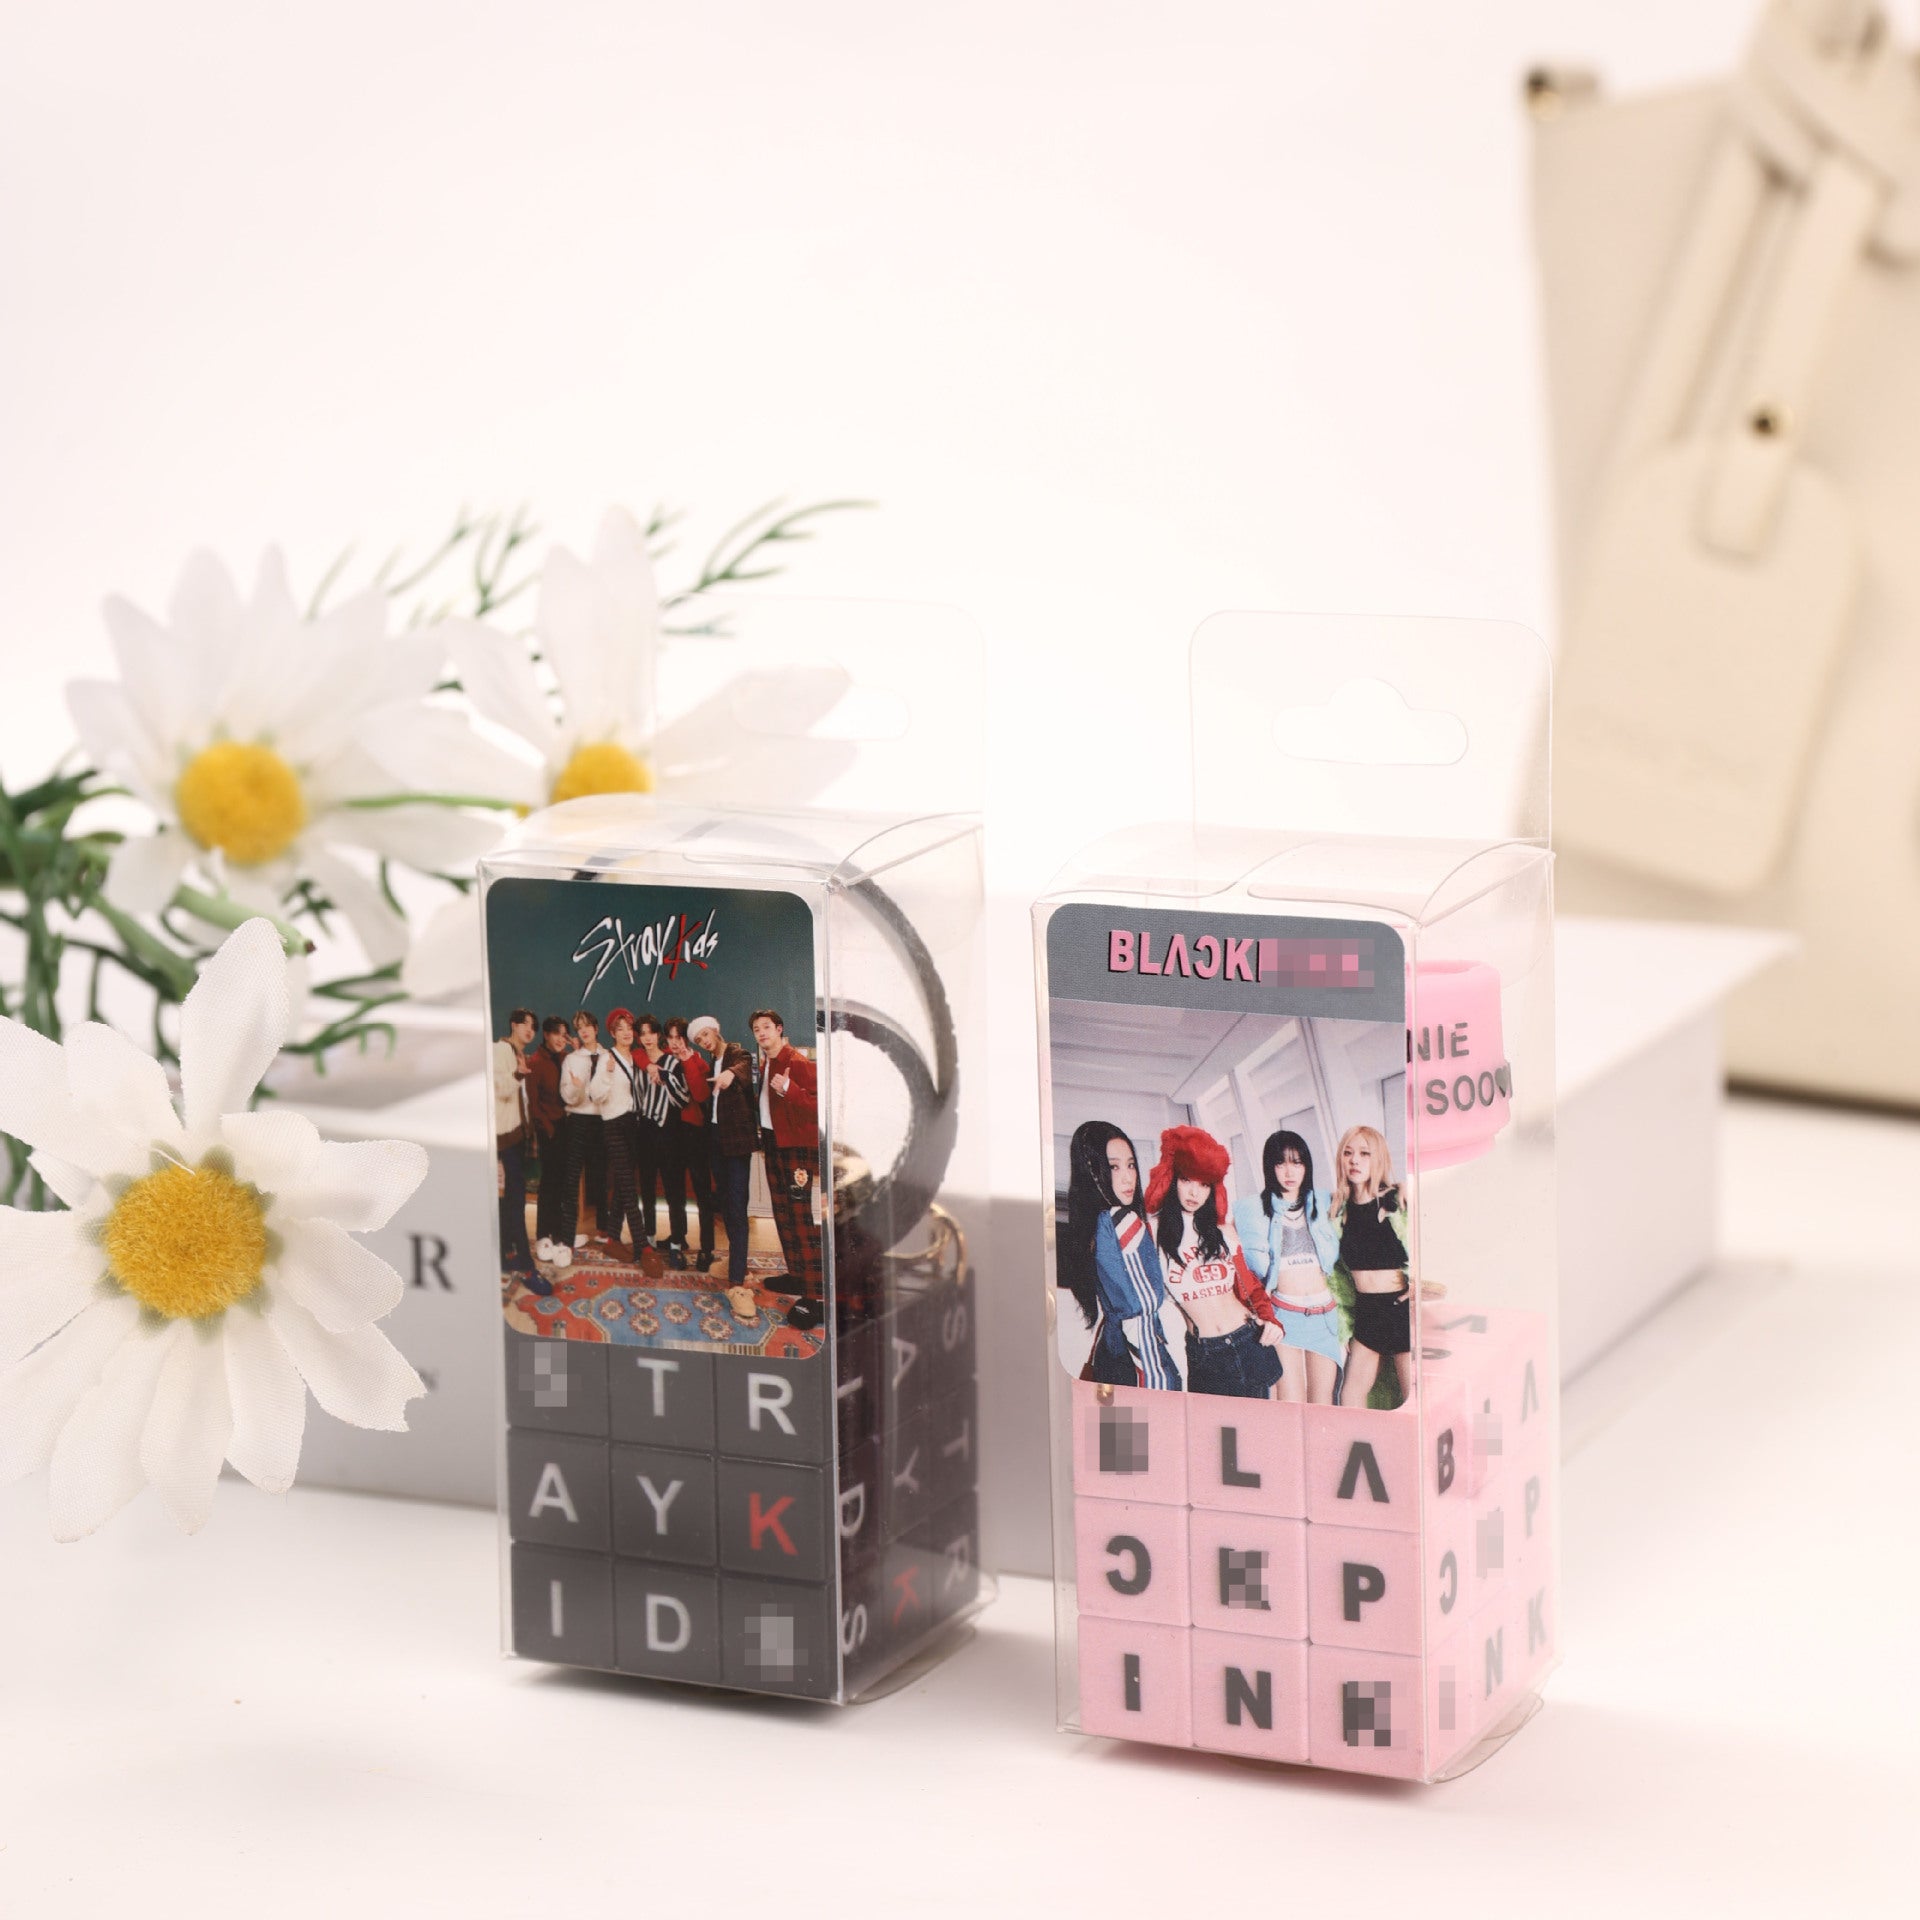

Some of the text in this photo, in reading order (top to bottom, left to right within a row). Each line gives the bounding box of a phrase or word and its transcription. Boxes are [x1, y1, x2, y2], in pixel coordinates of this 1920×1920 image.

[637, 1357, 680, 1417] T
[747, 1372, 797, 1436] R
[1220, 1426, 1261, 1489] L
[528, 1462, 799, 1556] A Y K
[645, 1593, 692, 1653] D
[1342, 1561, 1386, 1623] P
[1224, 1666, 1273, 1730] N
